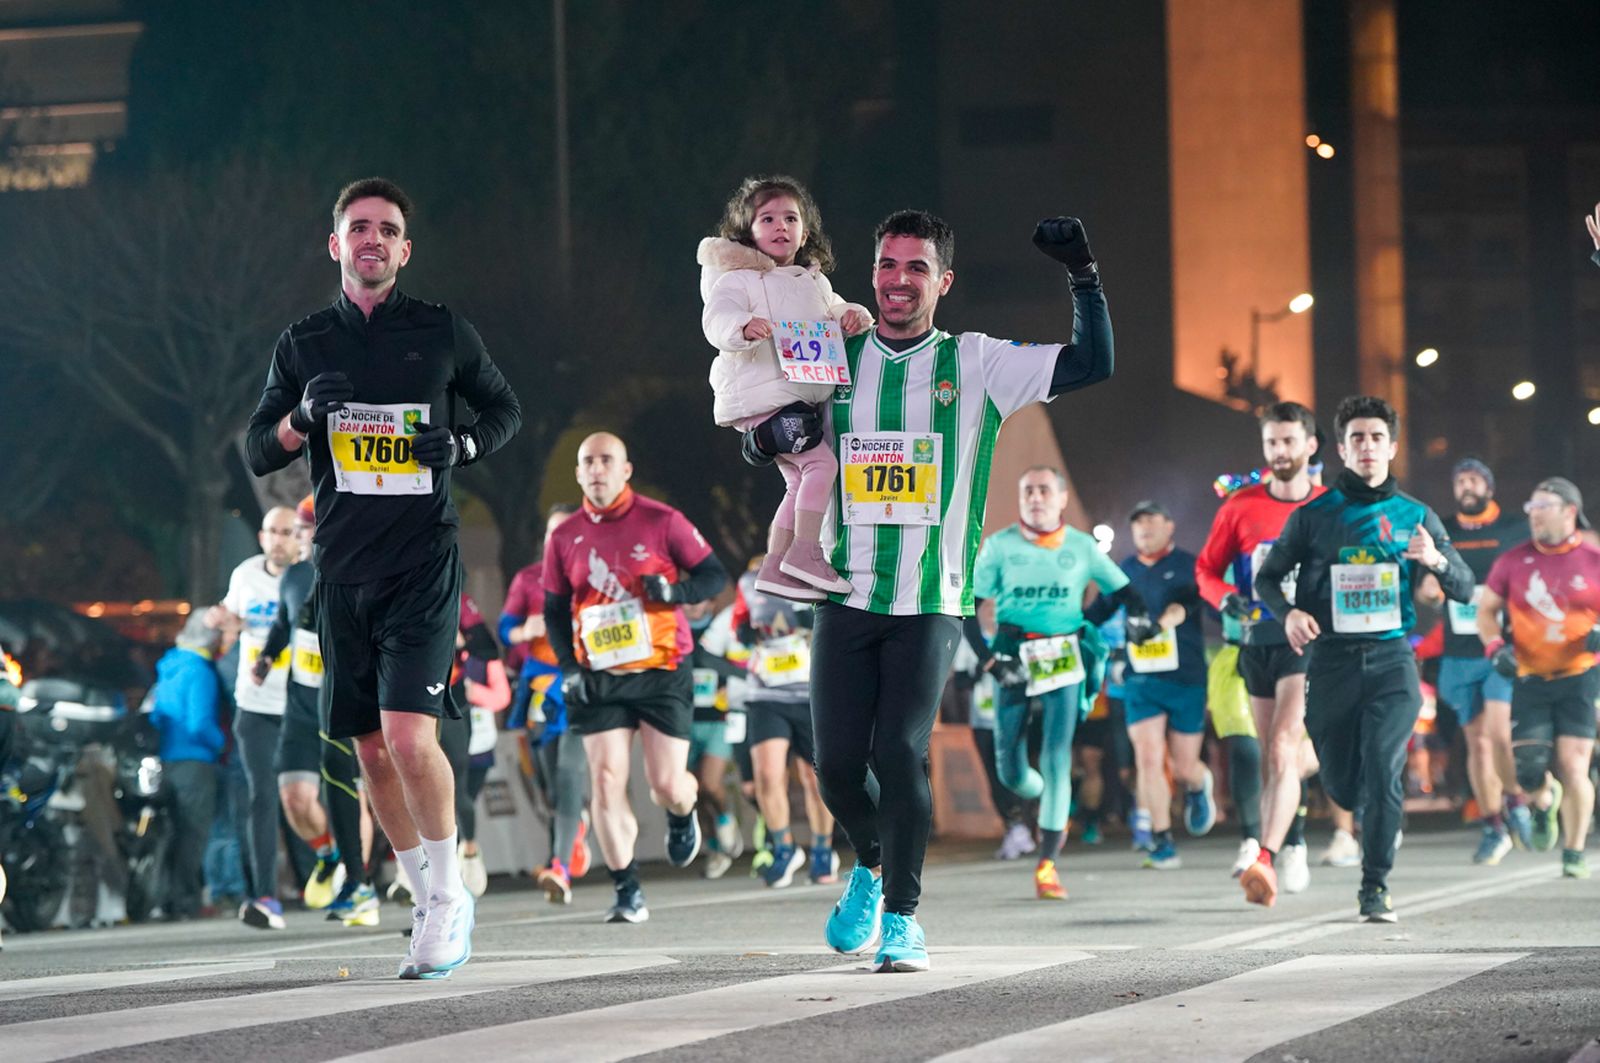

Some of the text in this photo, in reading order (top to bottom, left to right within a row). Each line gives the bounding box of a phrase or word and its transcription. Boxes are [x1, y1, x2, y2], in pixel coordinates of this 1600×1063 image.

[792, 340, 822, 362] 19
[785, 365, 849, 383] IRENE
[351, 412, 395, 423] NOCHE DE
[339, 423, 360, 432] SAN
[361, 421, 395, 434] ANTÓN
[350, 436, 410, 464] 1760
[862, 442, 904, 451] NOCHE DE
[851, 453, 870, 463] SAN
[870, 451, 904, 463] ANTÓN
[863, 465, 916, 492] 1761
[1013, 581, 1069, 599] serás
[1344, 590, 1390, 609] 13413
[593, 623, 632, 648] 8903
